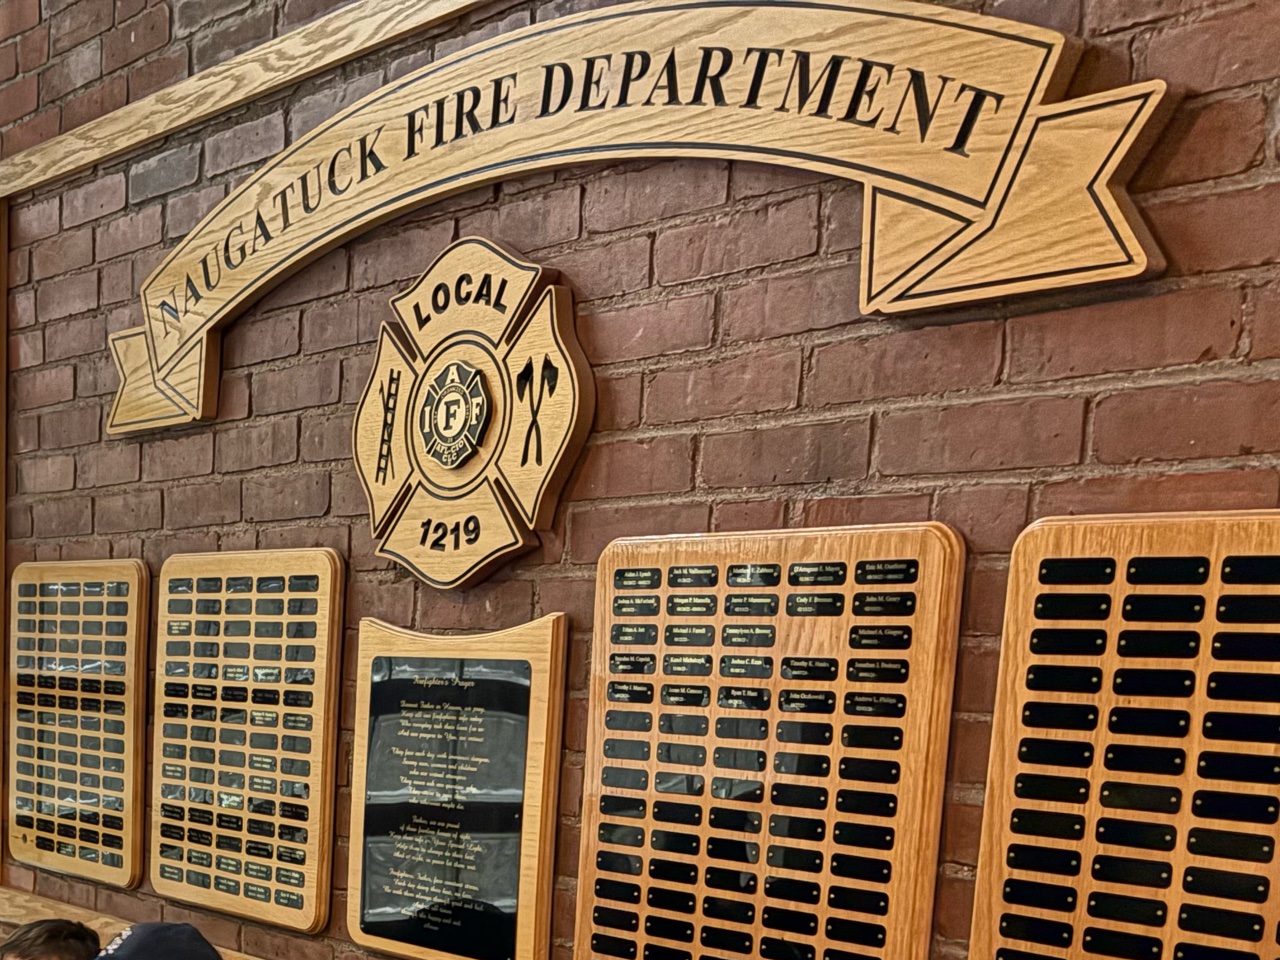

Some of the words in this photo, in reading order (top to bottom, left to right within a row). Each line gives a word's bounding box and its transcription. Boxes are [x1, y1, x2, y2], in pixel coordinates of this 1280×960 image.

[157, 124, 389, 339] NAUGATUCK
[403, 72, 518, 161] FIRE
[535, 46, 1006, 158] DEPARTMENT
[413, 273, 508, 332] LOCAL
[419, 515, 481, 552] 1219
